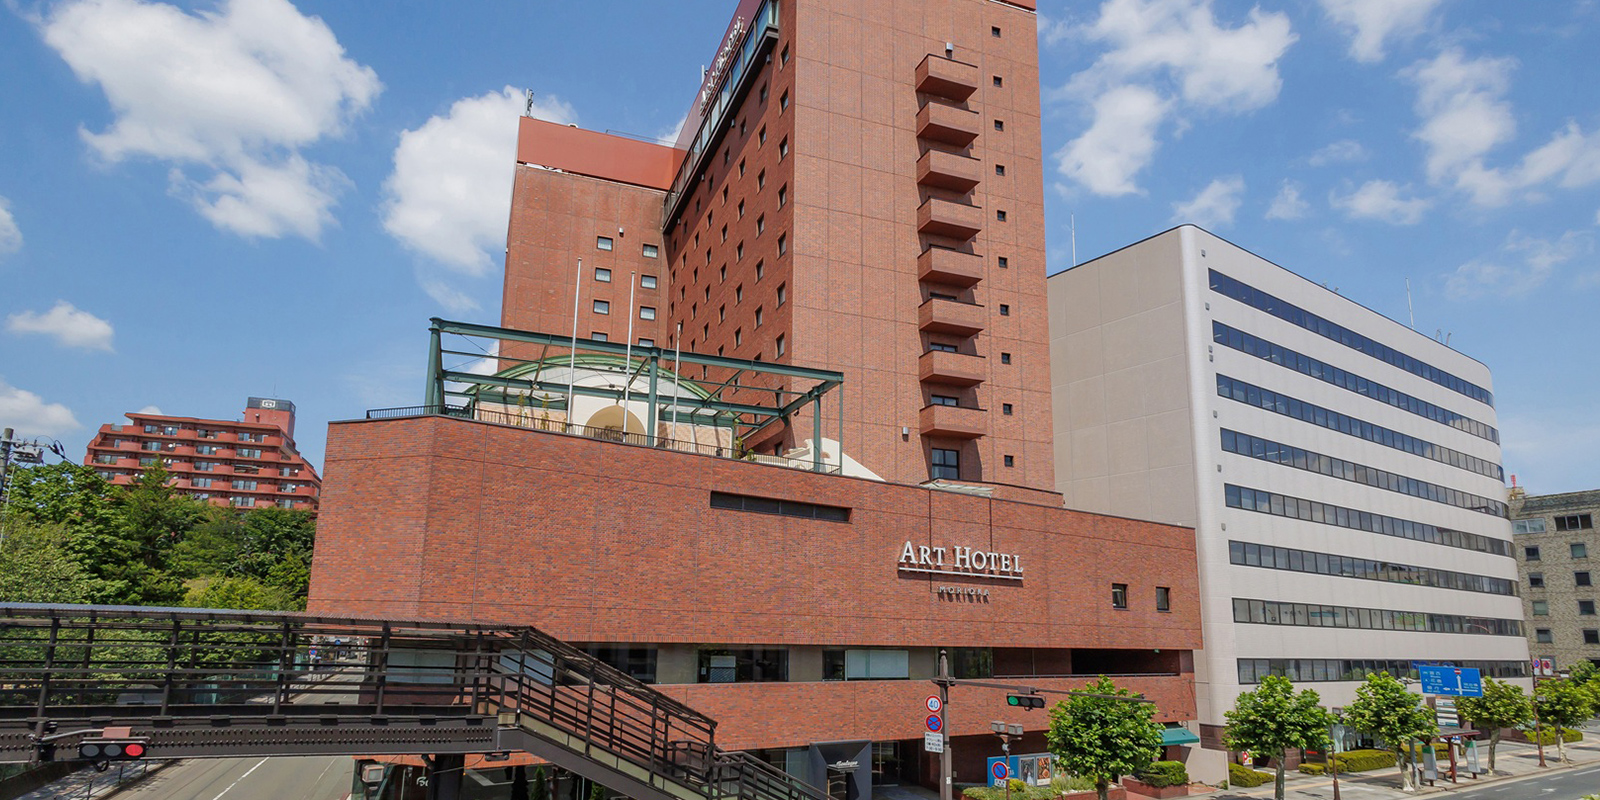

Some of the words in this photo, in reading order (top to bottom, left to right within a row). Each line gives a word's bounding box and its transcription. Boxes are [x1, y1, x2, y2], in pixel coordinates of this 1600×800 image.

[899, 541, 946, 566] ART
[954, 546, 1024, 573] HOTEL
[939, 586, 990, 596] MORIOKA
[928, 700, 939, 709] 40
